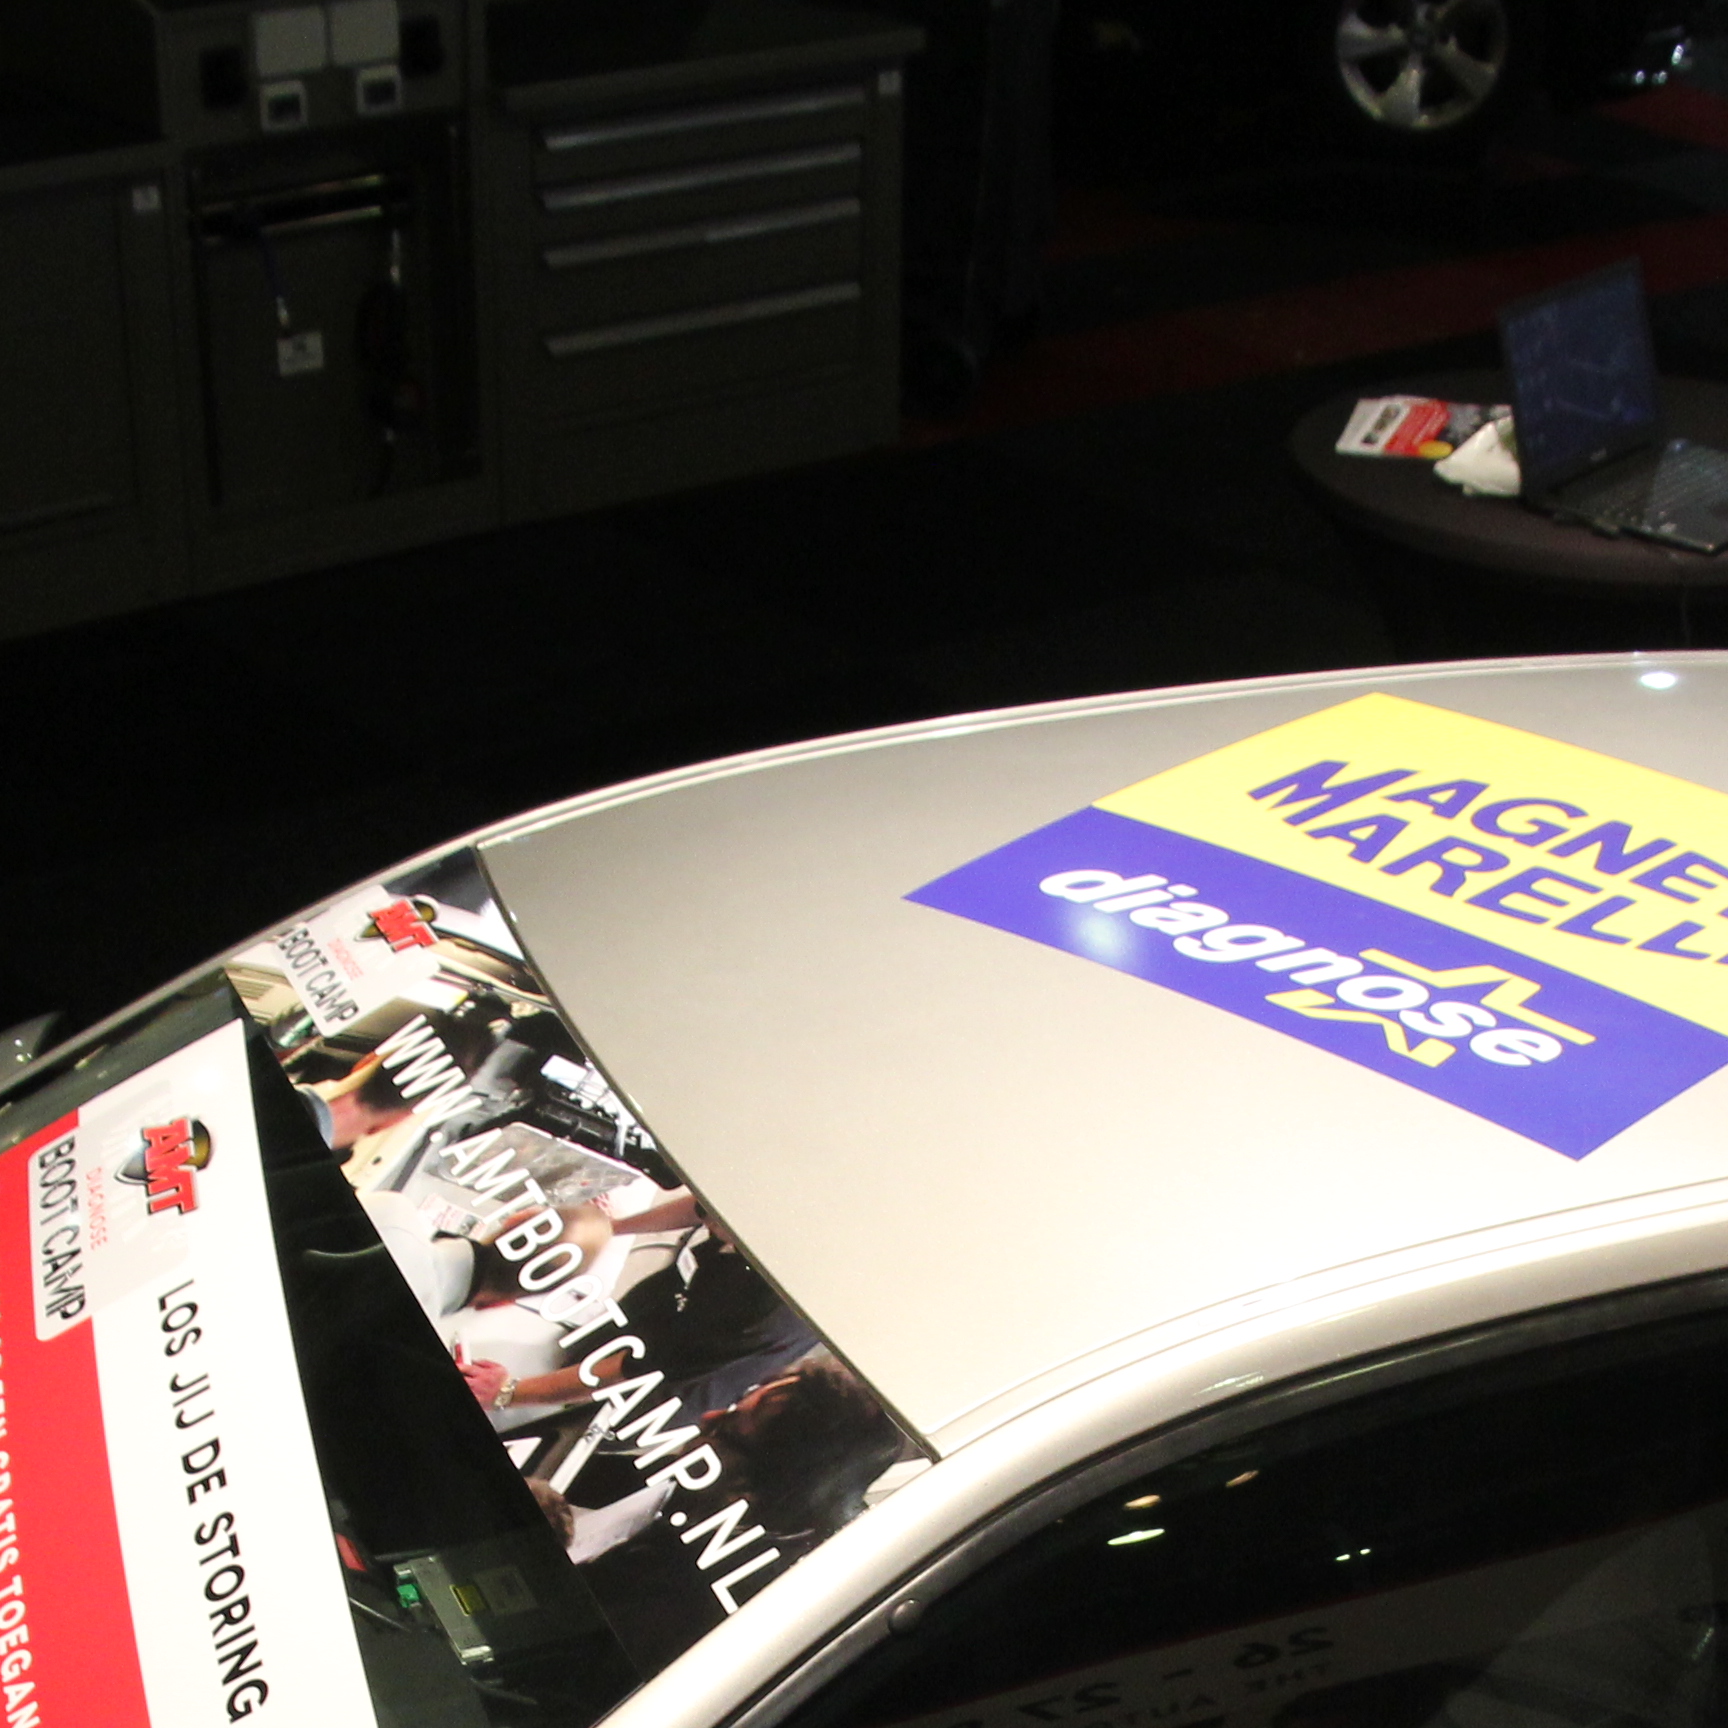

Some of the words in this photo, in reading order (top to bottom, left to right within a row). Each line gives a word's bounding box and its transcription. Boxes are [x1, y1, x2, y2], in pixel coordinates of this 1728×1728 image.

[369, 898, 440, 953] AMT
[1039, 869, 1563, 1066] diagnose
[278, 927, 329, 978] BOOT
[305, 969, 359, 1024] CAMP
[38, 1135, 79, 1226] BOOT
[143, 1116, 200, 1216] AMT
[41, 1225, 86, 1320] CAMP
[157, 1277, 202, 1357] LOS
[375, 1013, 780, 1617] WWW.AMTBOOTCAMP.NL
[169, 1373, 216, 1430] JIJ
[181, 1436, 228, 1506] DE
[194, 1511, 270, 1724] STORING
